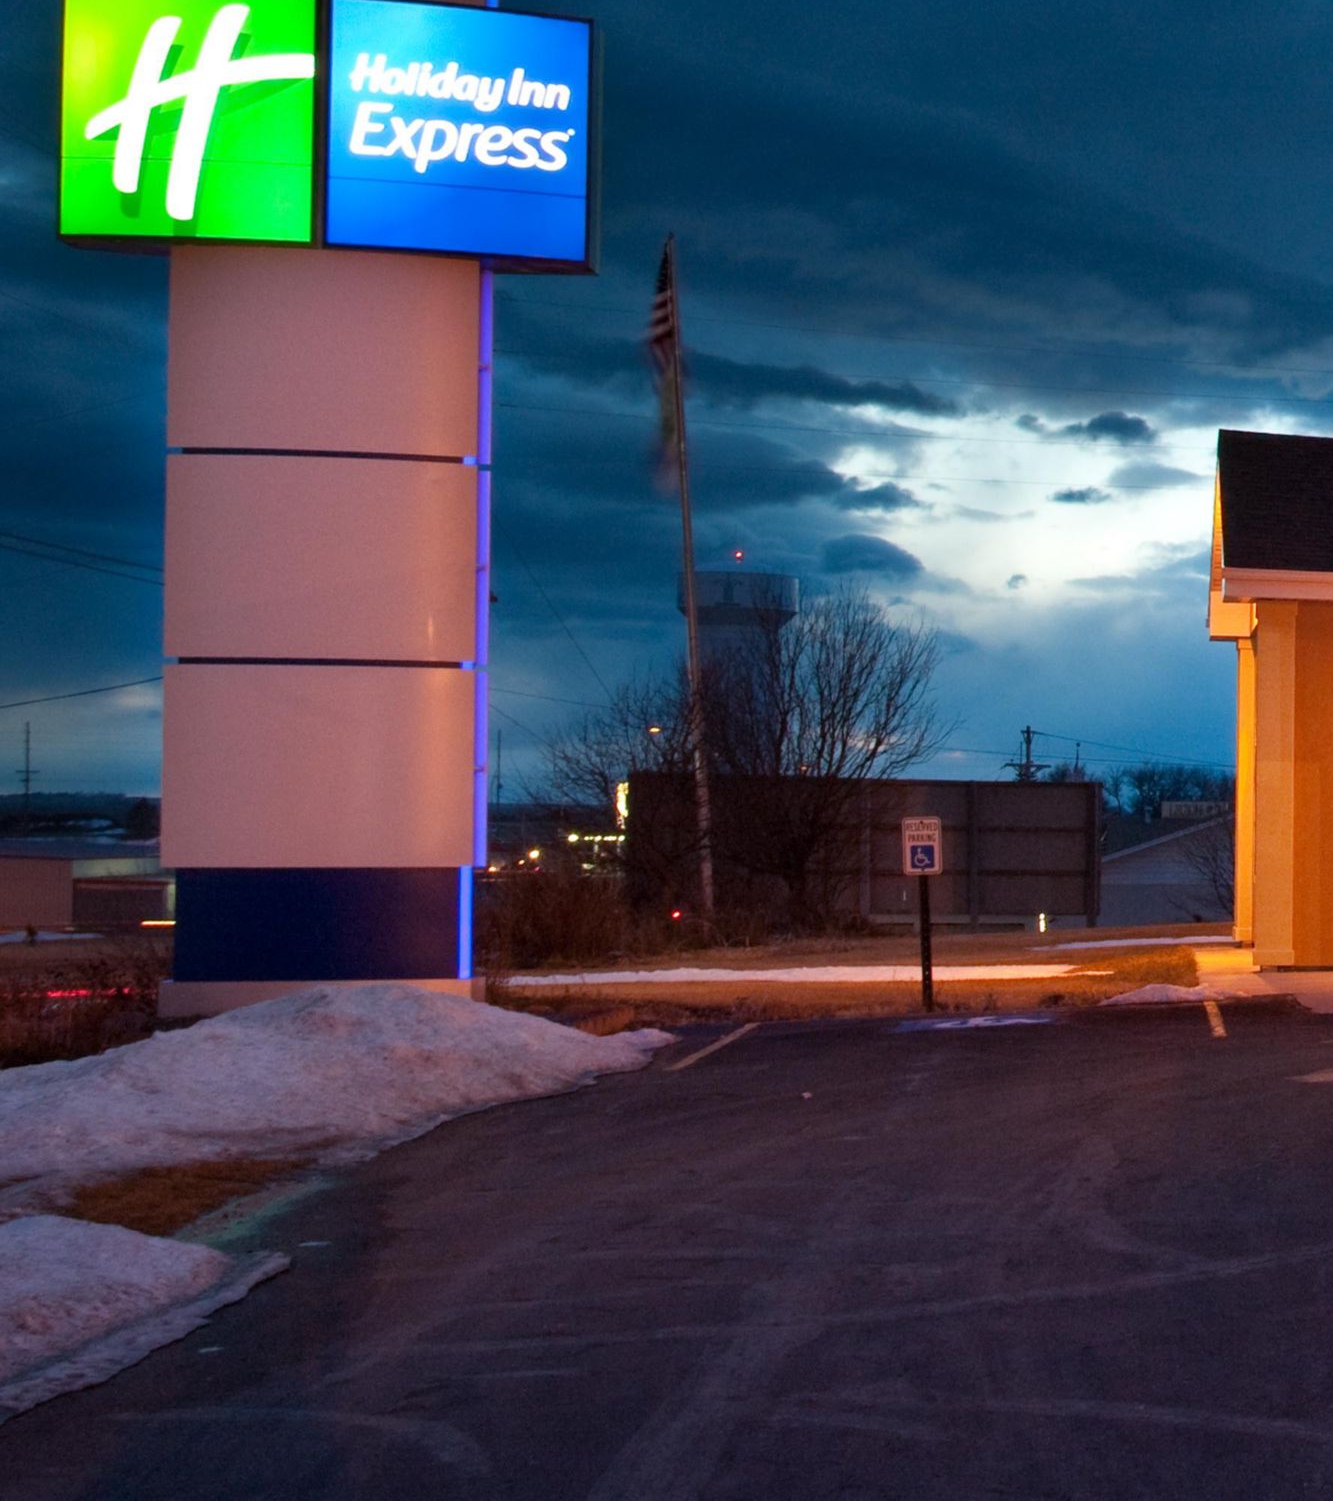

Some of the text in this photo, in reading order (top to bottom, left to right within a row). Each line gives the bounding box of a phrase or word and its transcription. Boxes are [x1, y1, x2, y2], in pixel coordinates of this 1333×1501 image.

[349, 52, 572, 113] Holiday Inn
[348, 100, 570, 174] Express
[905, 822, 937, 832] RESERVED
[907, 833, 937, 842] PARKING
